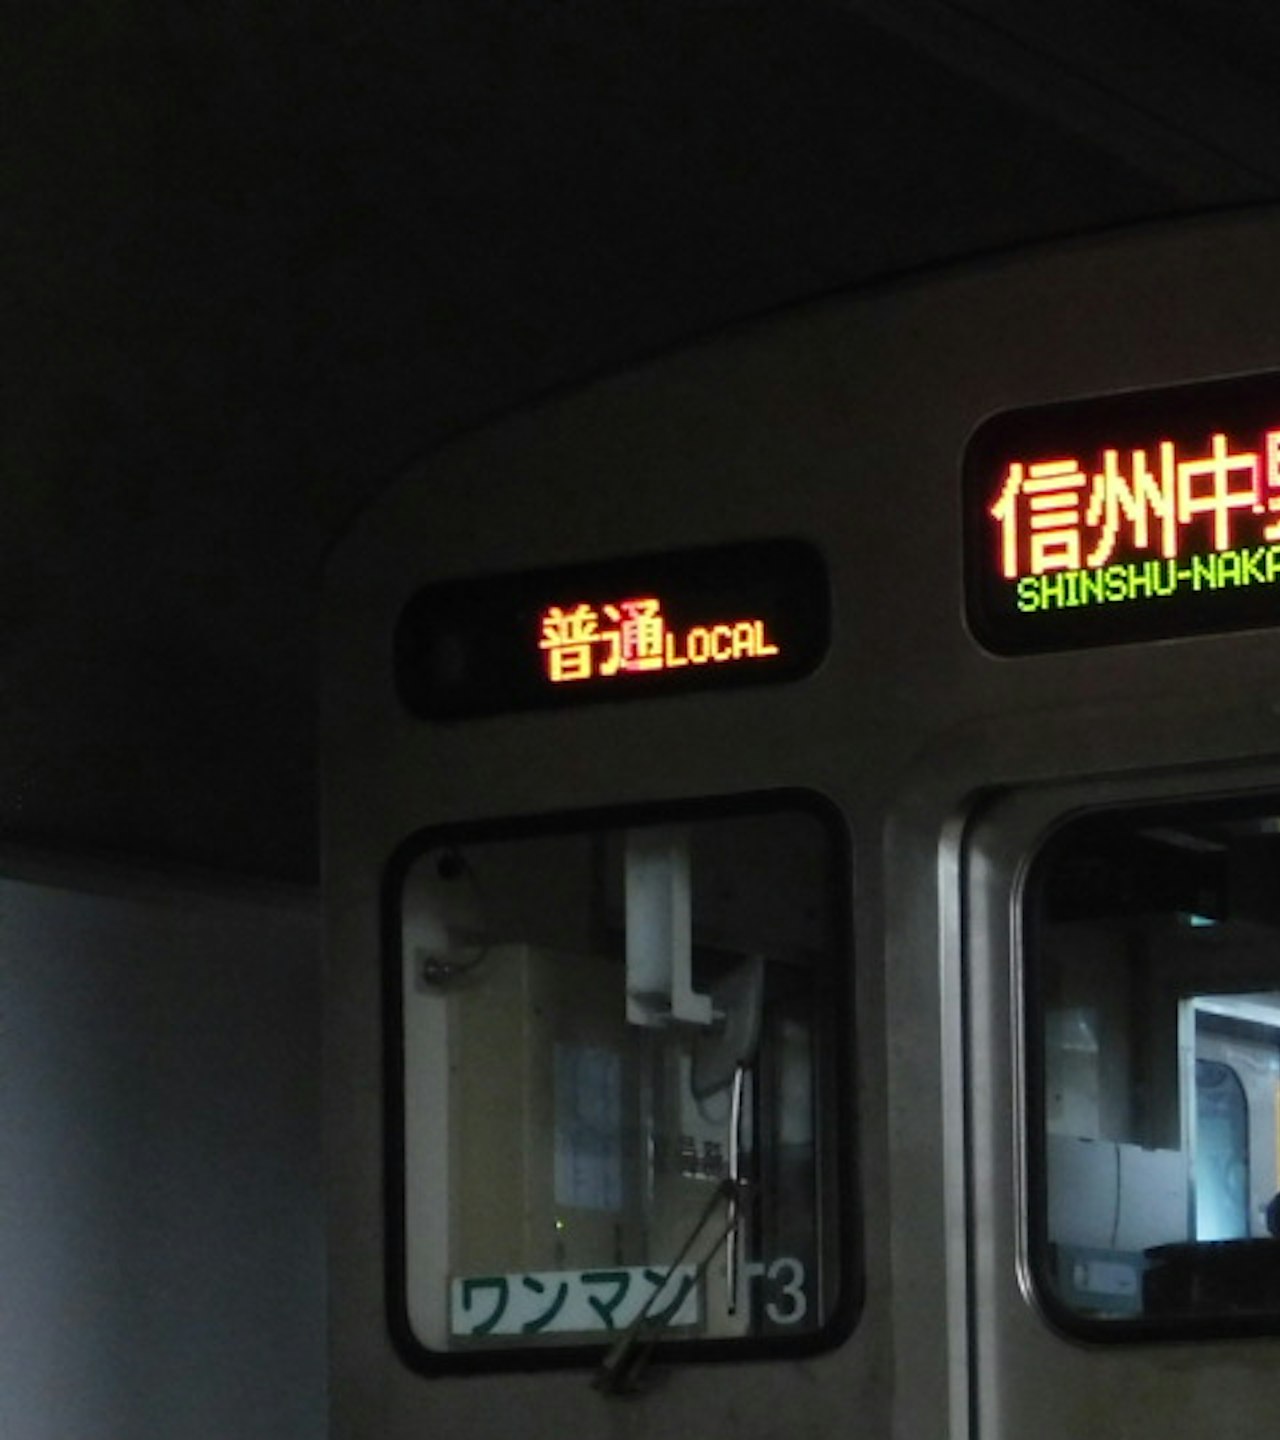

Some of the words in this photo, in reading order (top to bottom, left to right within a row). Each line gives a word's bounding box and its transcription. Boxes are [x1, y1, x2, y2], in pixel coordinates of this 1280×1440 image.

[540, 599, 664, 683] 普通
[665, 620, 778, 669] LOCAL
[462, 1269, 695, 1333] ワンマン
